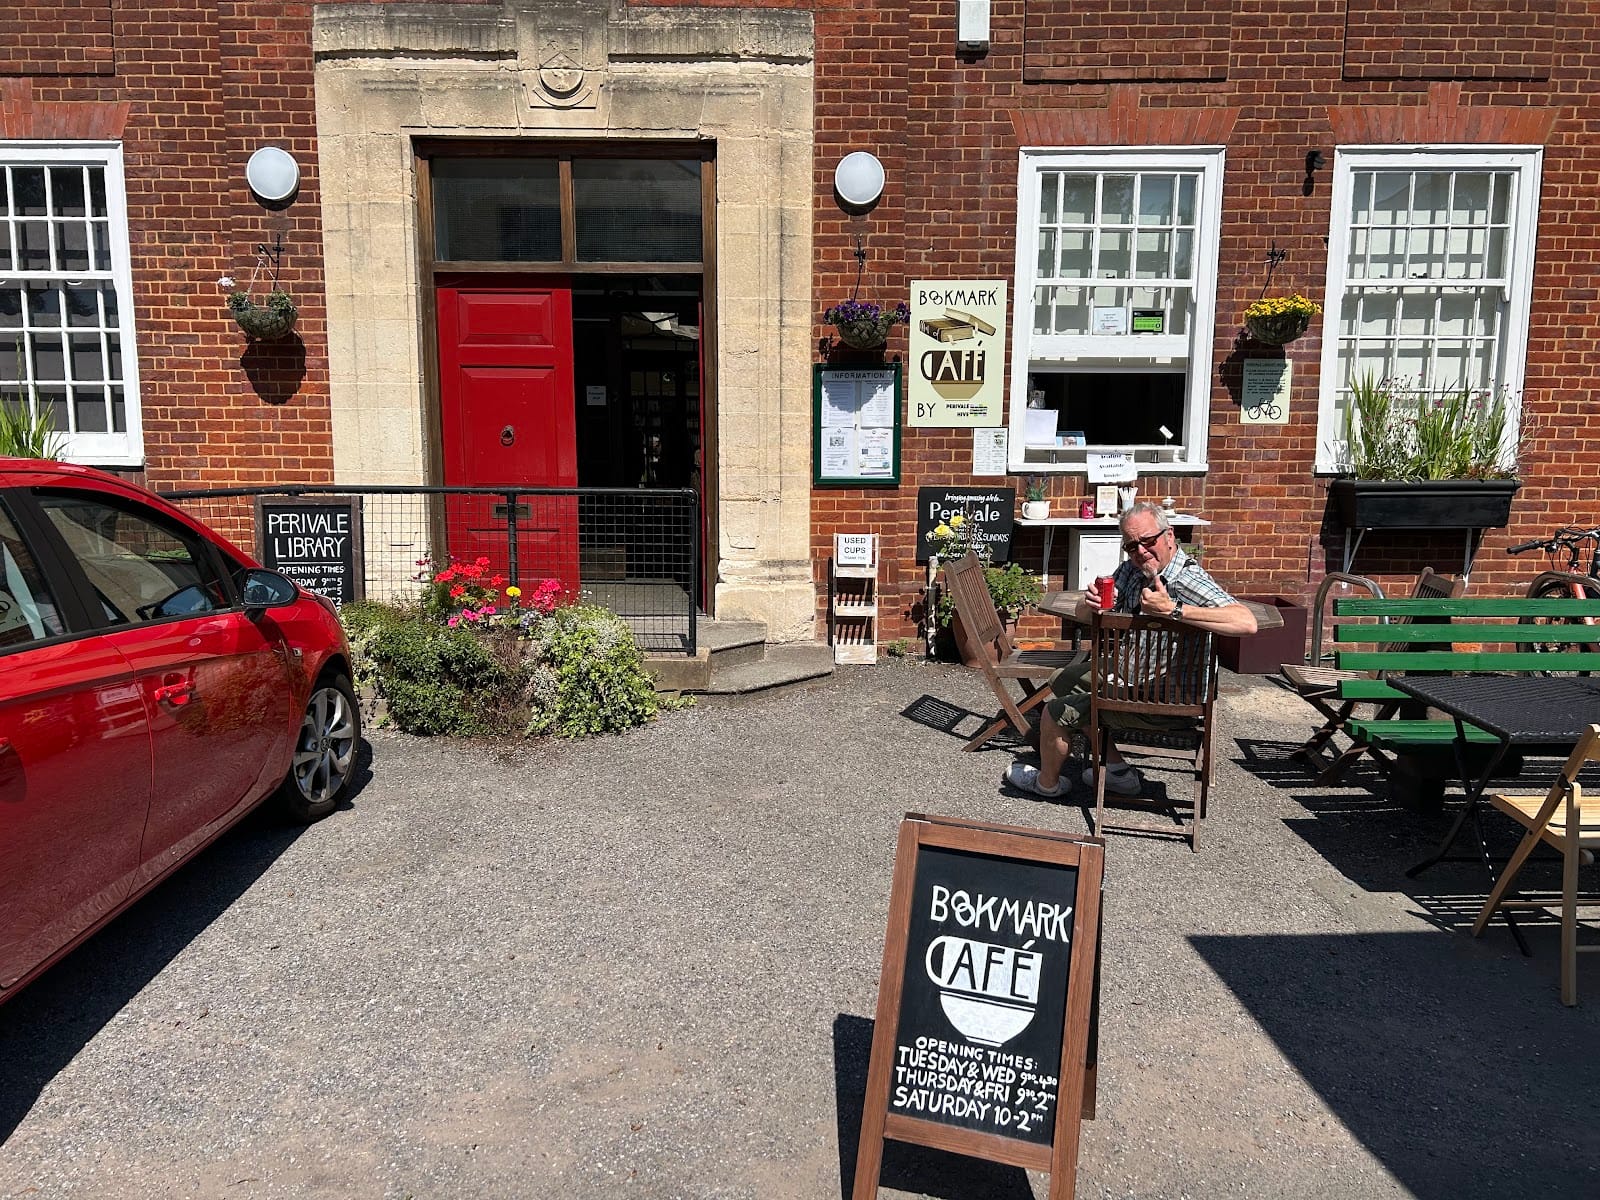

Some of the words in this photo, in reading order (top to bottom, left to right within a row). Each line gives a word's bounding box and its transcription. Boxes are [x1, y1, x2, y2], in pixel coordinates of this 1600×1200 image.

[919, 289, 997, 306] BOOKMARK
[920, 340, 985, 381] CAFÉ
[917, 402, 936, 418] BY
[929, 502, 1000, 522] Perivale
[268, 513, 349, 534] PERIVALE
[274, 537, 346, 558] LIBRARY
[844, 546, 867, 554] CUPS
[277, 566, 321, 575] OPENING
[321, 565, 345, 574] TIMES
[930, 884, 1073, 943] BOOKMARK
[924, 935, 1041, 1003] CAFÉ
[915, 1036, 984, 1061] OPENING
[987, 1050, 1039, 1070] TIMES:
[981, 1064, 1017, 1084] WED
[893, 1085, 992, 1121] SATURDAY
